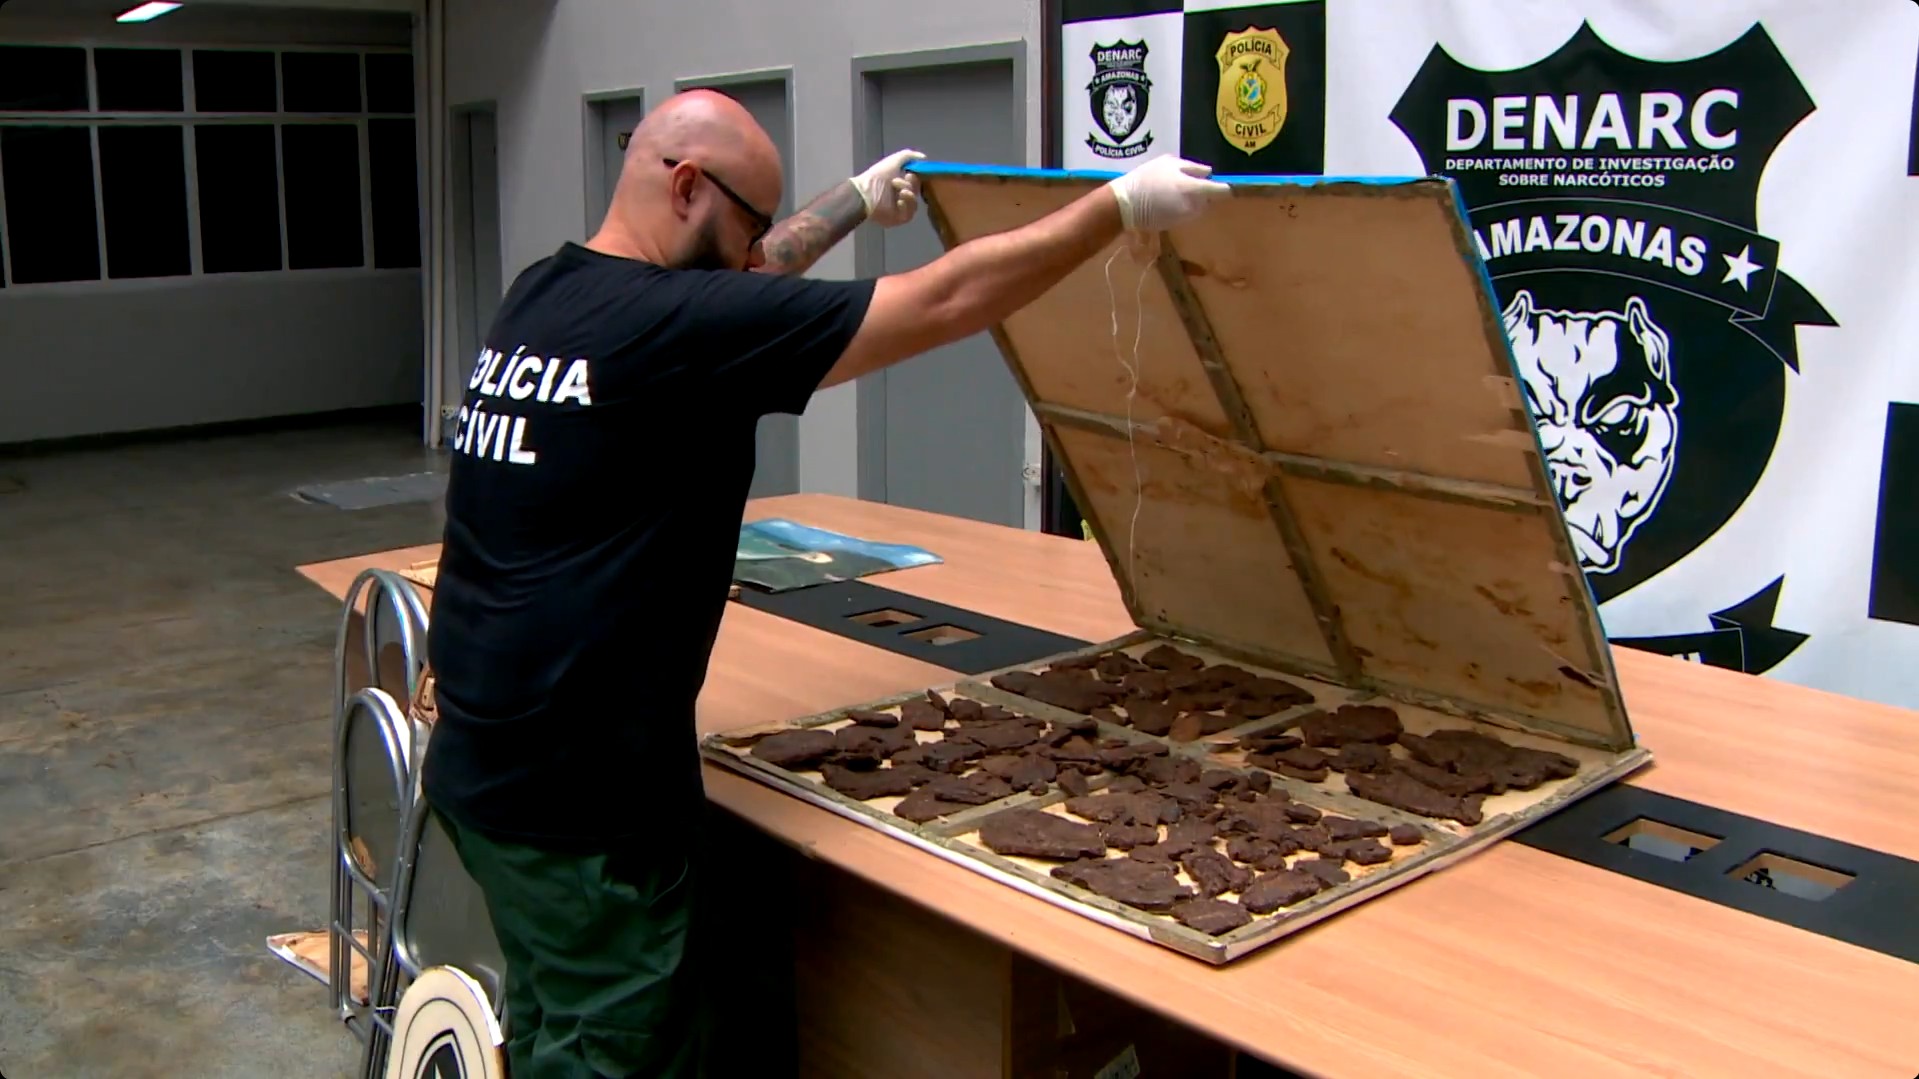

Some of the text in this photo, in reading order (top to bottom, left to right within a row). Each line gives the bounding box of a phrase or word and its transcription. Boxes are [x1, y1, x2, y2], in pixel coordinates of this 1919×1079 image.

[1230, 37, 1272, 57] POLÍCIA
[1097, 48, 1142, 62] DENARC
[1101, 71, 1140, 82] AMAZONAS
[1445, 88, 1739, 152] DENARC
[1235, 123, 1267, 137] CIVIL
[1124, 144, 1146, 156] CIVIL
[1244, 141, 1257, 149] AM
[1445, 154, 1735, 173] DEPARTAMENTO DE INVESTIGAÇÃO
[1498, 172, 1666, 188] SOBRE NARCÓTICOS
[469, 345, 592, 406] OLÍCIA
